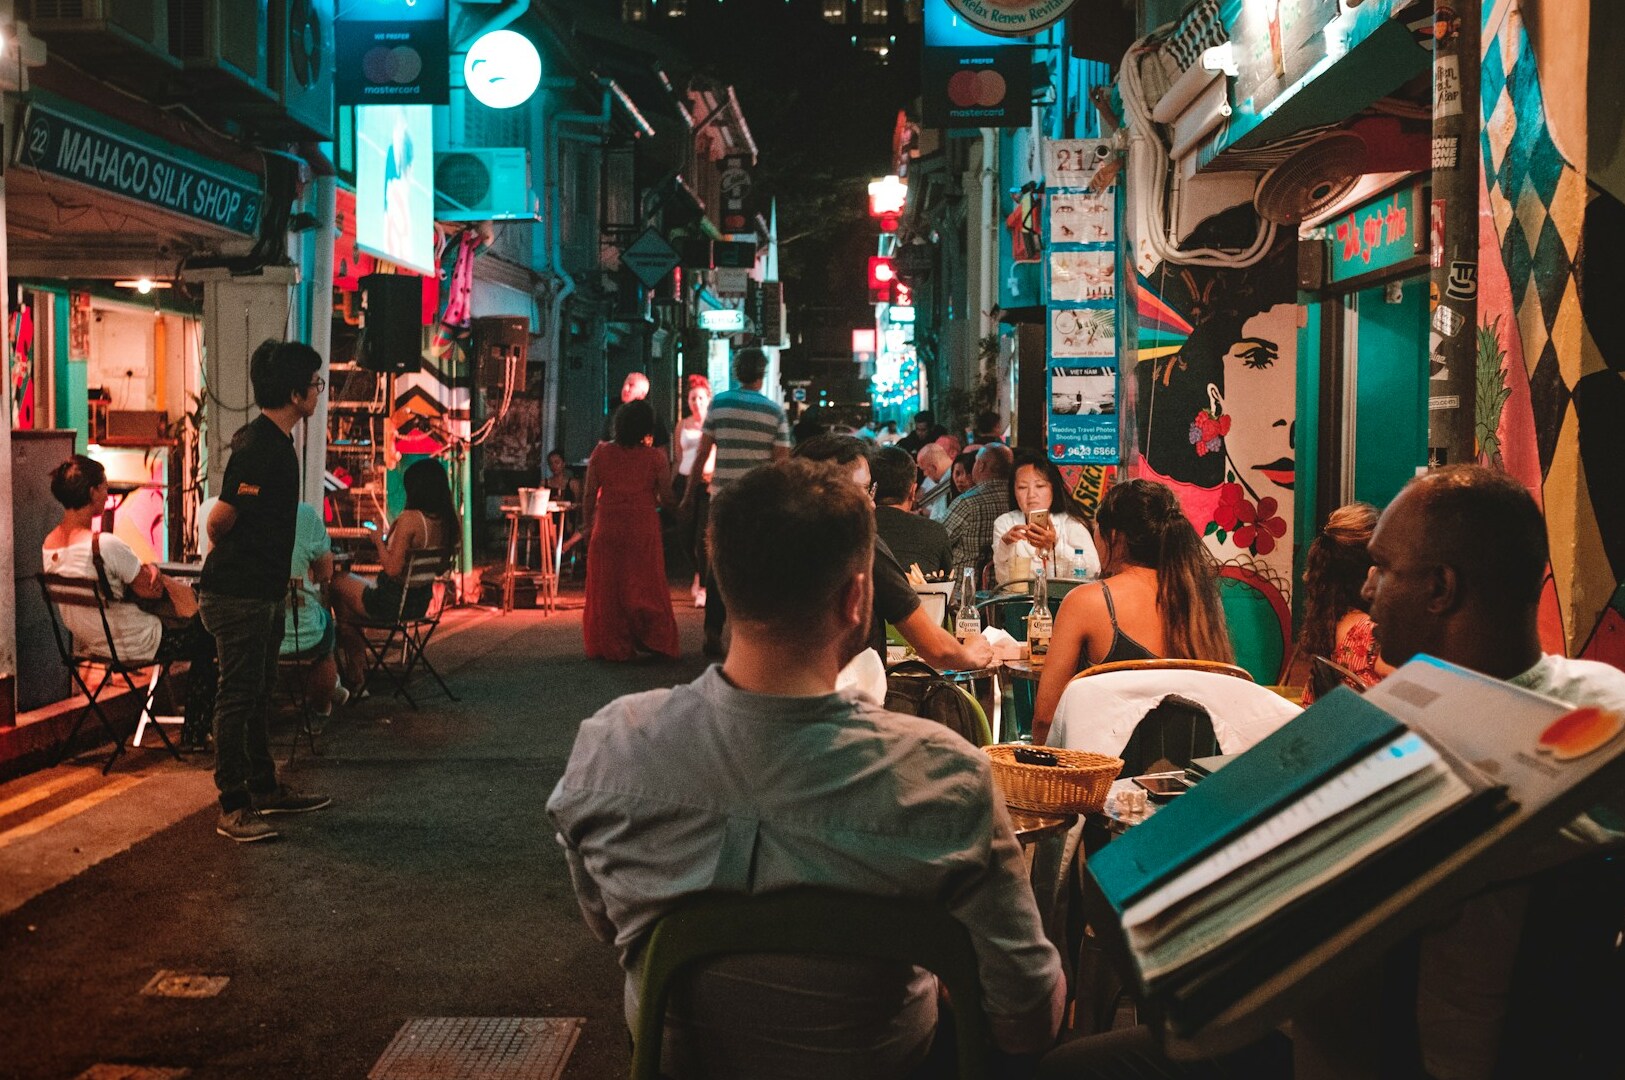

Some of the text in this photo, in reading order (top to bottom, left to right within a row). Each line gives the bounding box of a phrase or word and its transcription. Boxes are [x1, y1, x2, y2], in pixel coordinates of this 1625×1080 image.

[991, 9, 1026, 24] Renew
[1029, 0, 1064, 21] Revita
[363, 84, 421, 94] mastercard
[950, 108, 1005, 117] mastercard
[30, 127, 48, 154] 22
[56, 127, 149, 194] MAHACO
[148, 162, 194, 210] SILK
[193, 180, 241, 224] SHOP
[958, 621, 979, 629] Corona
